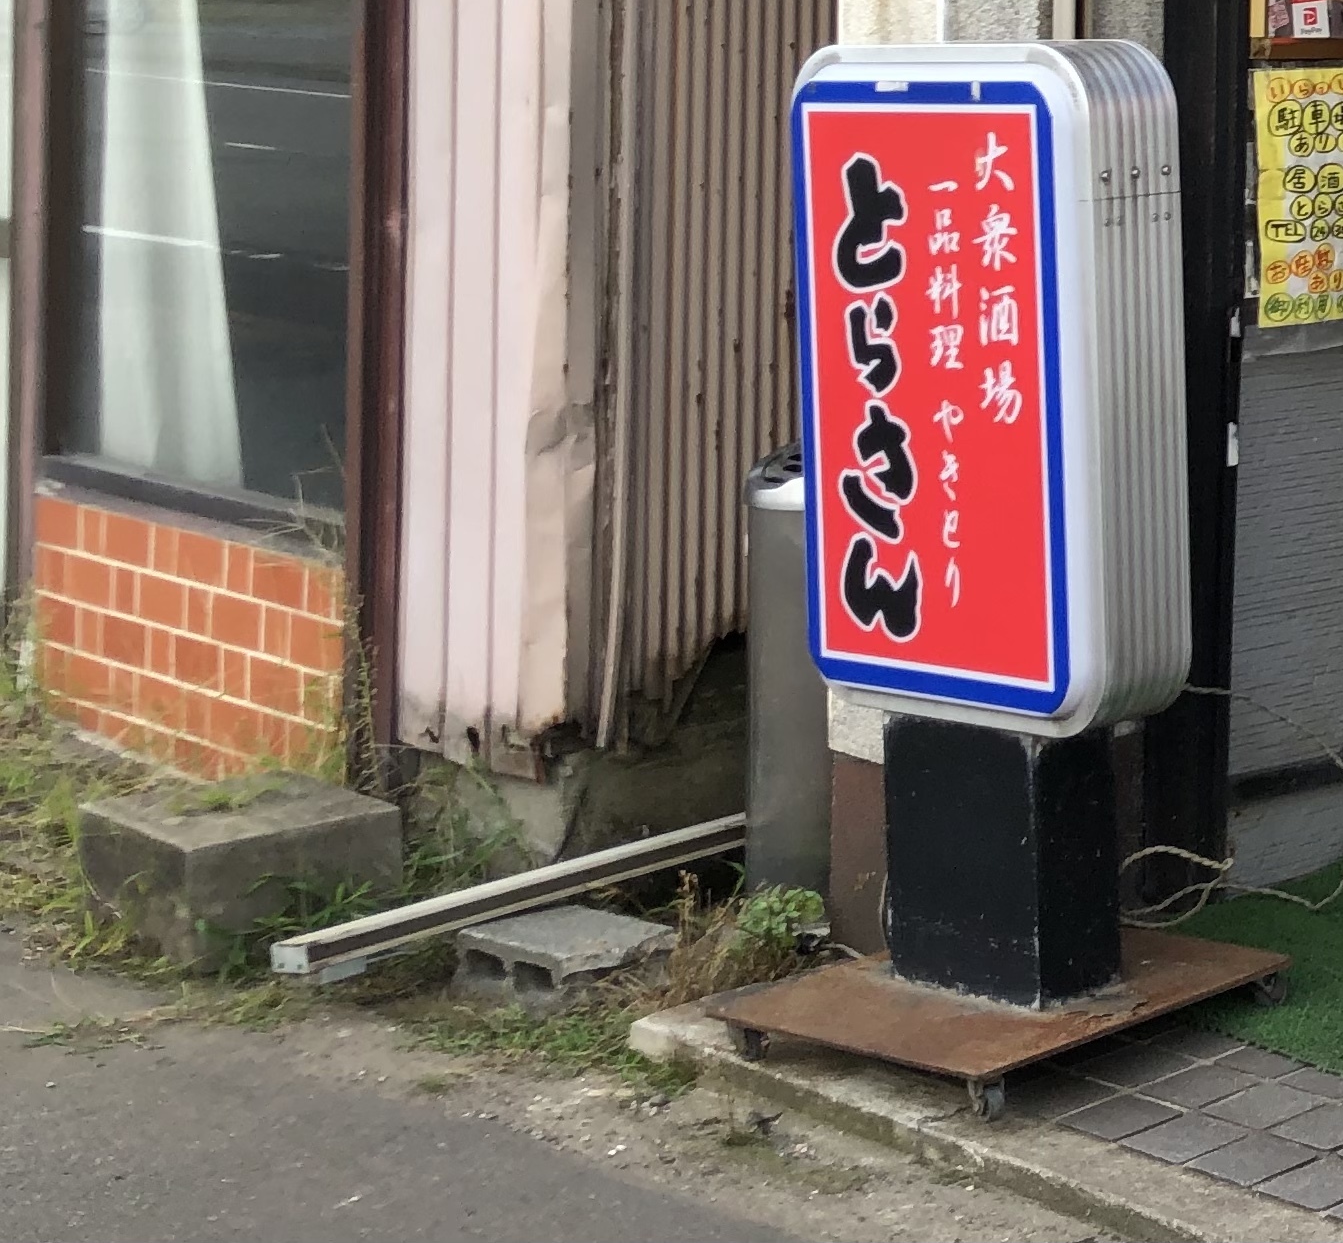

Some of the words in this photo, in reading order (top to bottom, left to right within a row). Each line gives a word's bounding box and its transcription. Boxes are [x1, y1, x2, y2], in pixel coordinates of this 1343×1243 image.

[925, 181, 964, 371] 一品料理
[973, 132, 1023, 425] 大衆酒場
[1270, 223, 1303, 238] TEL
[832, 152, 923, 642] とらさん
